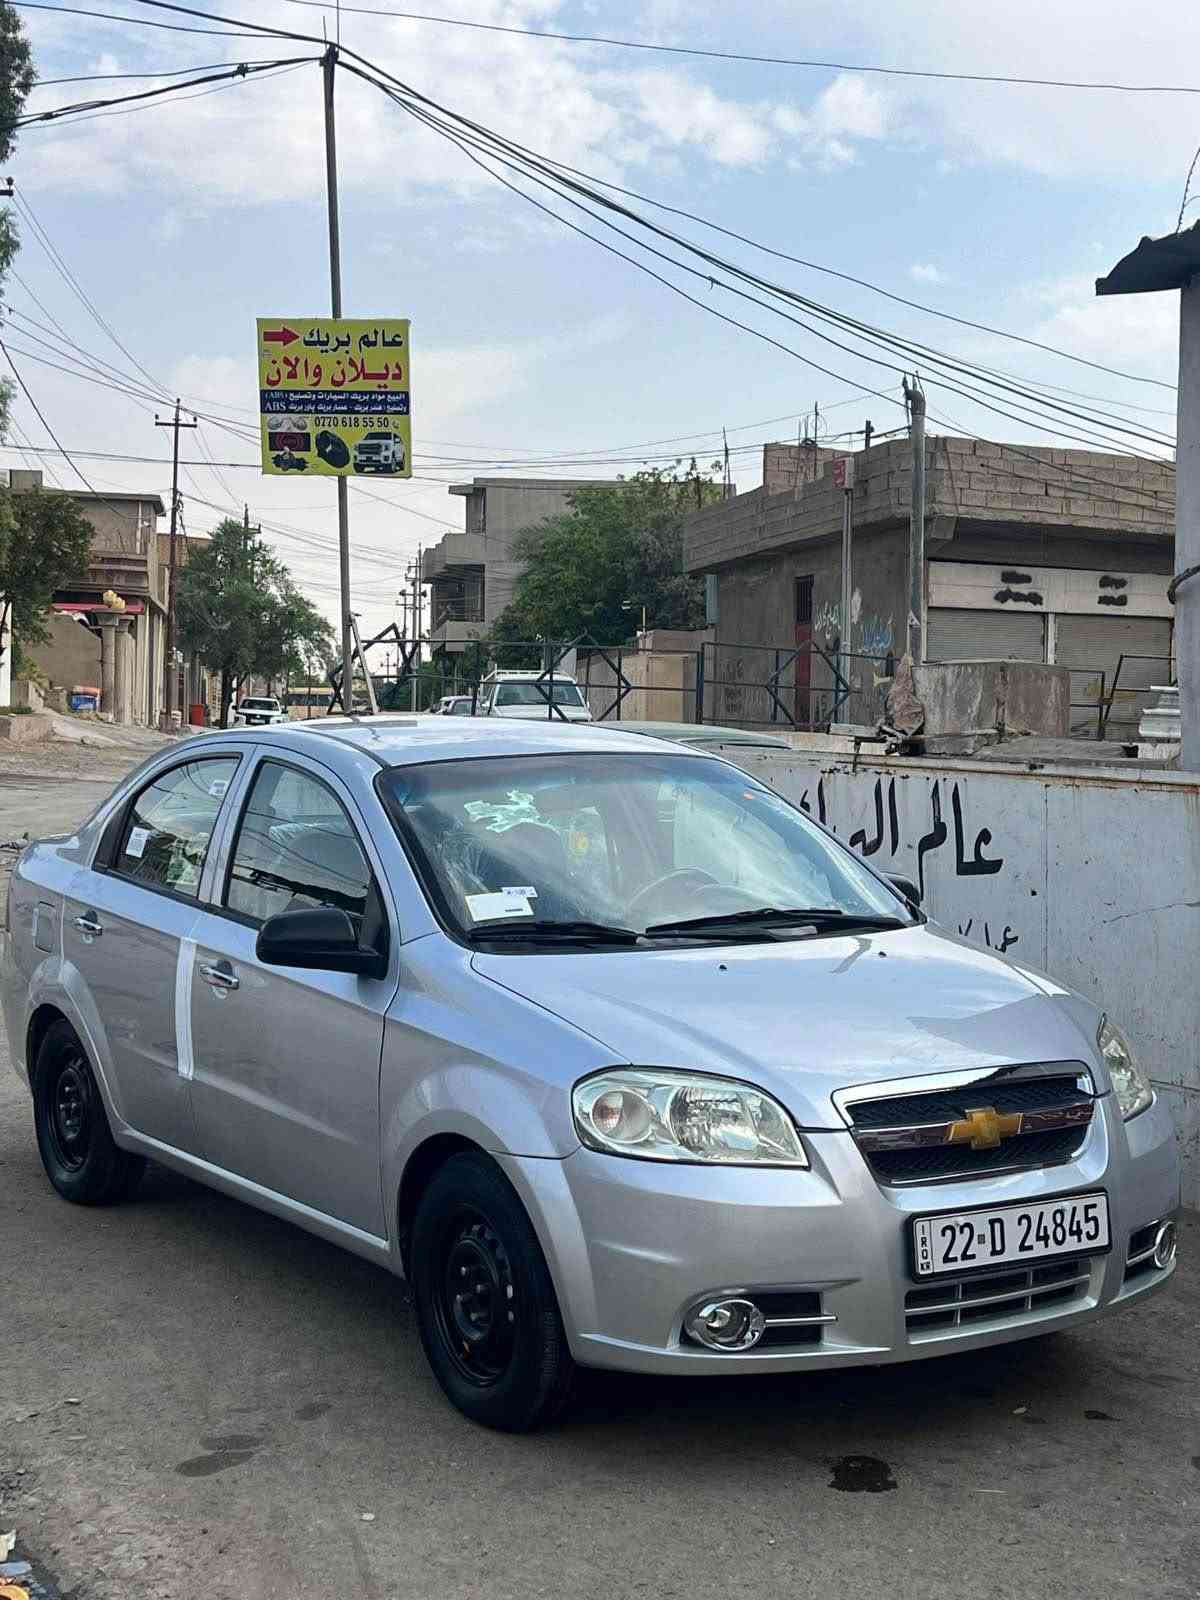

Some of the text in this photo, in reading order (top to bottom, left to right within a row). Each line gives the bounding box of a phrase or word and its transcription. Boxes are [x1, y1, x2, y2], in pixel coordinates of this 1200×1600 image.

[303, 328, 403, 353] عالم بريك
[330, 356, 402, 389] ديلان
[264, 401, 287, 411] ABS
[314, 416, 389, 428] 0770 618 55 50
[918, 779, 1004, 901] عالم
[940, 1203, 1100, 1264] 22 D 24845
